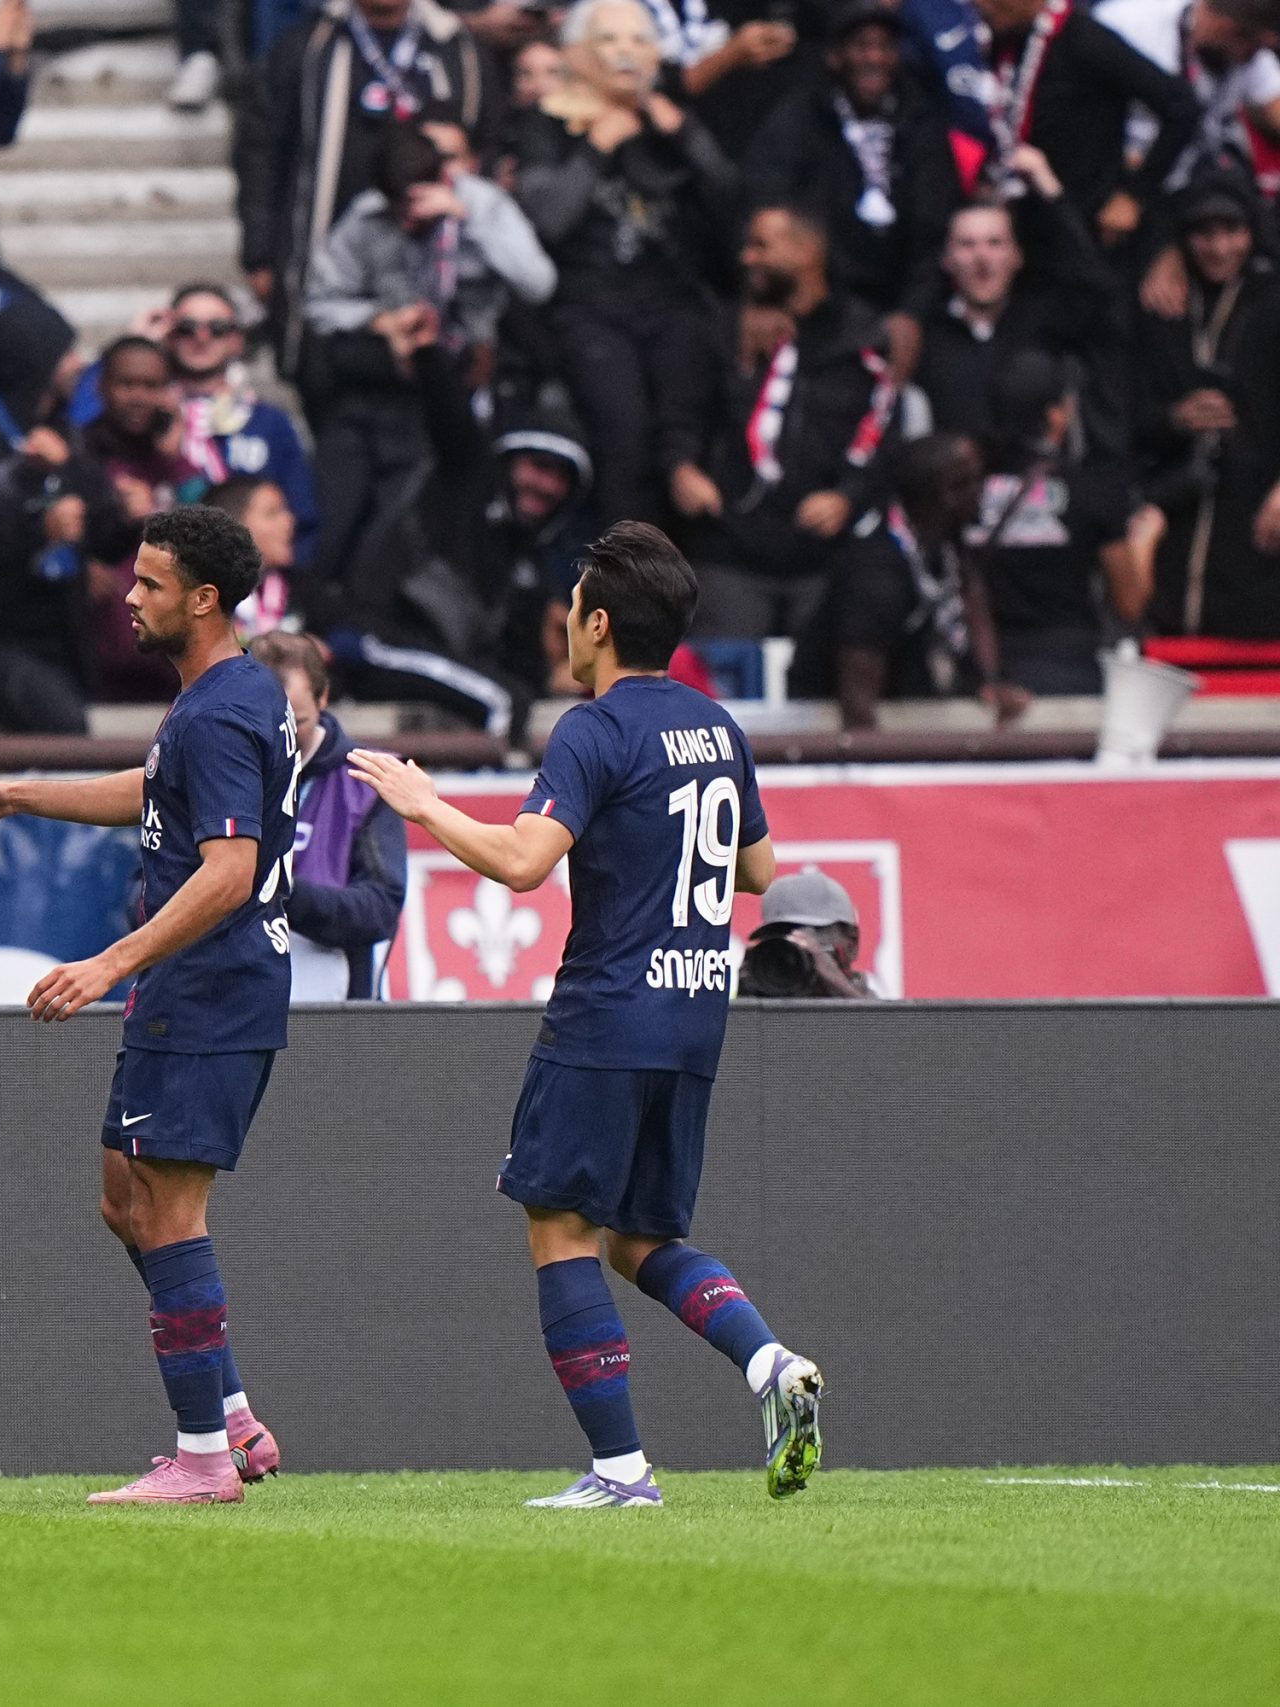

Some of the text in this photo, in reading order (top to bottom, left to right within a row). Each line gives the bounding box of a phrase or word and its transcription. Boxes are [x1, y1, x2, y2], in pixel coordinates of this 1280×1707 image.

[660, 728, 718, 767] KANG
[668, 776, 741, 928] 19
[646, 948, 726, 998] snipes
